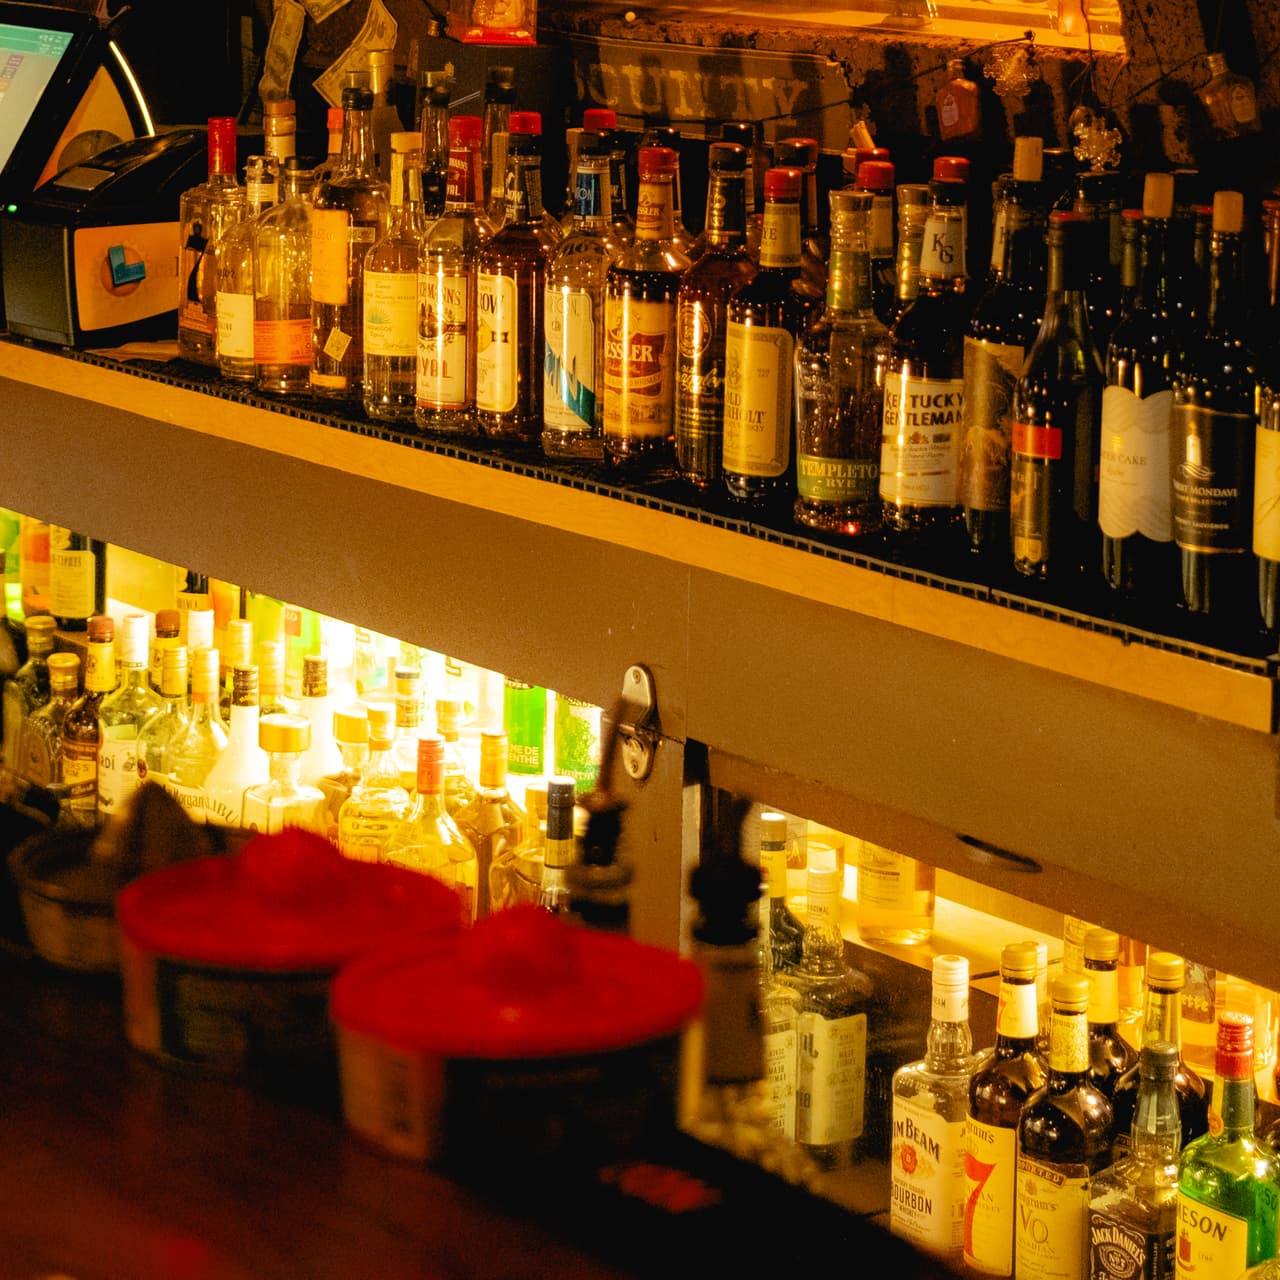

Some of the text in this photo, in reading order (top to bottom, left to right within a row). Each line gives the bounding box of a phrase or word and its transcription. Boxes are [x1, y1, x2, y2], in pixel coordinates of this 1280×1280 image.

[605, 340, 654, 363] ESSLER
[421, 357, 454, 379] YAL
[800, 459, 880, 479] TEMPLETO
[1121, 454, 1148, 467] CAKE
[826, 477, 857, 488] RYE
[1191, 484, 1239, 499] MONDAVI
[508, 754, 540, 765] ENTHE
[905, 1117, 941, 1162] BEAM
[894, 1183, 933, 1216] OURBON
[964, 1151, 998, 1258] 7
[1181, 1202, 1228, 1242] ESON
[1091, 1226, 1147, 1267] JACK DANIEL'S
